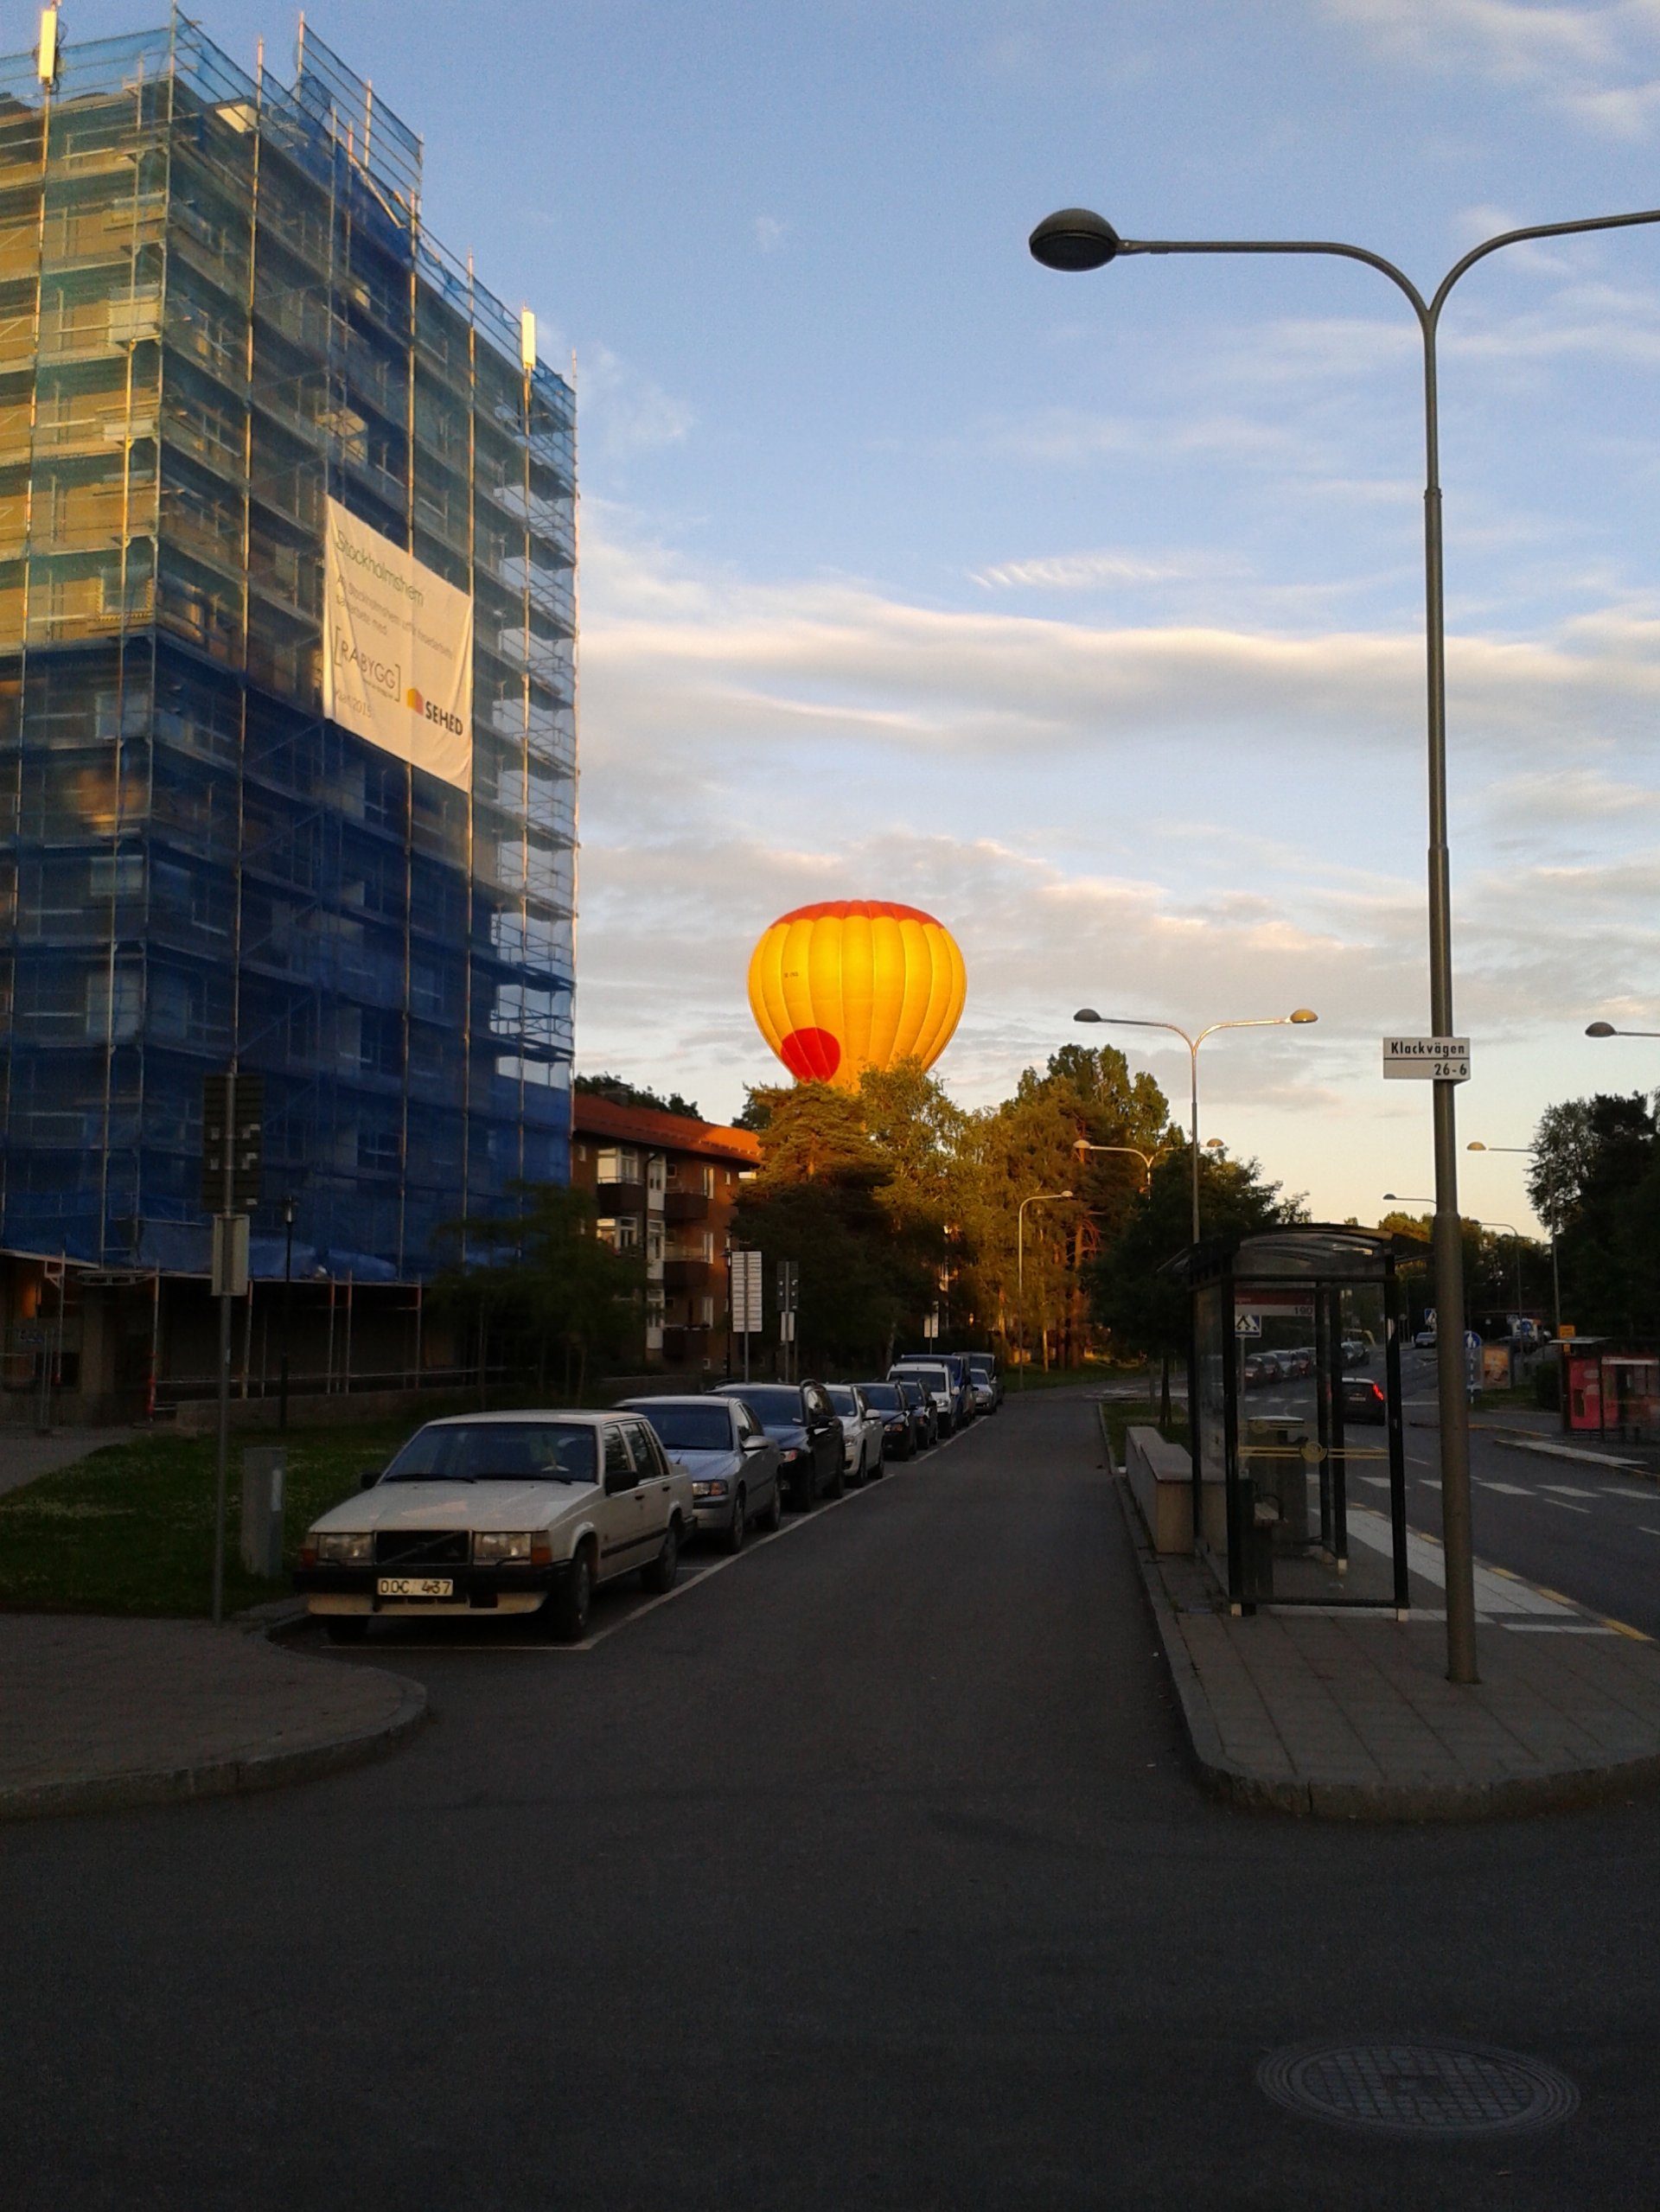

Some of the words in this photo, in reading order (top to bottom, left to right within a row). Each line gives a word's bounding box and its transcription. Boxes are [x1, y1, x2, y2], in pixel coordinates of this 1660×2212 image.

[337, 529, 424, 608] Stockholmshem
[425, 700, 463, 736] SEHED
[1391, 1042, 1465, 1057] Klackvägen
[421, 1581, 451, 1594] 437
